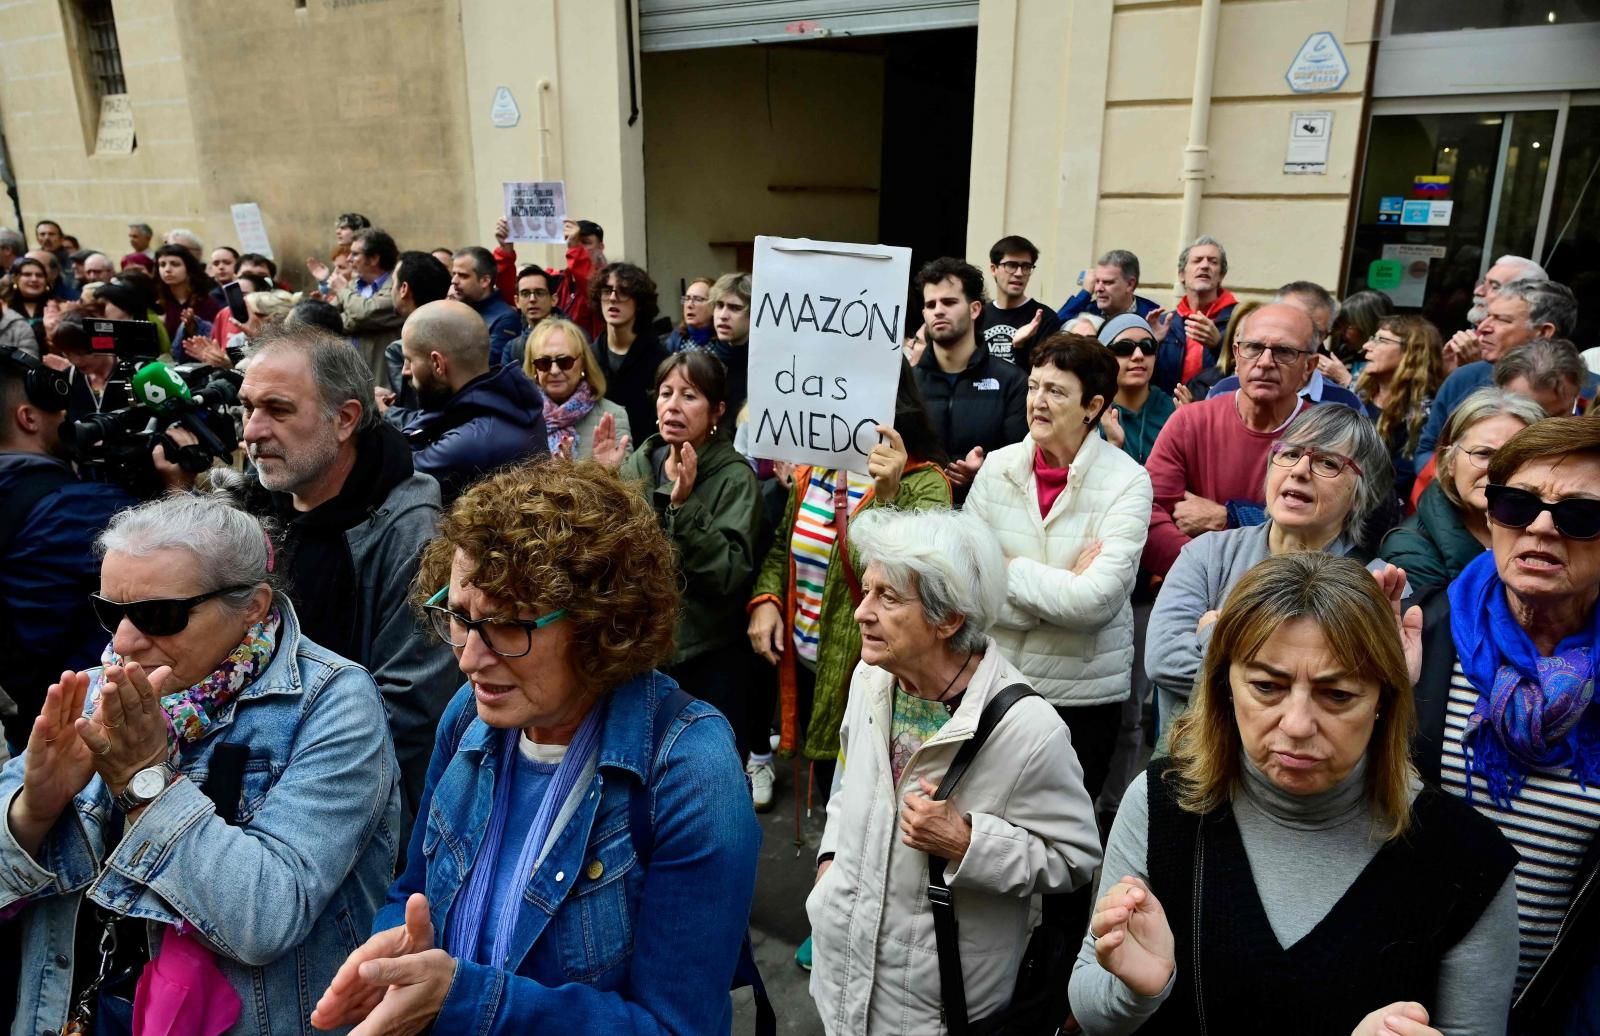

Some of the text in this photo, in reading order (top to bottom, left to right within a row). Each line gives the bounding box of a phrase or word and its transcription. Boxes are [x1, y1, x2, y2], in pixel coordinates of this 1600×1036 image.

[988, 342, 1012, 352] VANS
[774, 354, 848, 401] das
[755, 407, 884, 457] MIEDO
